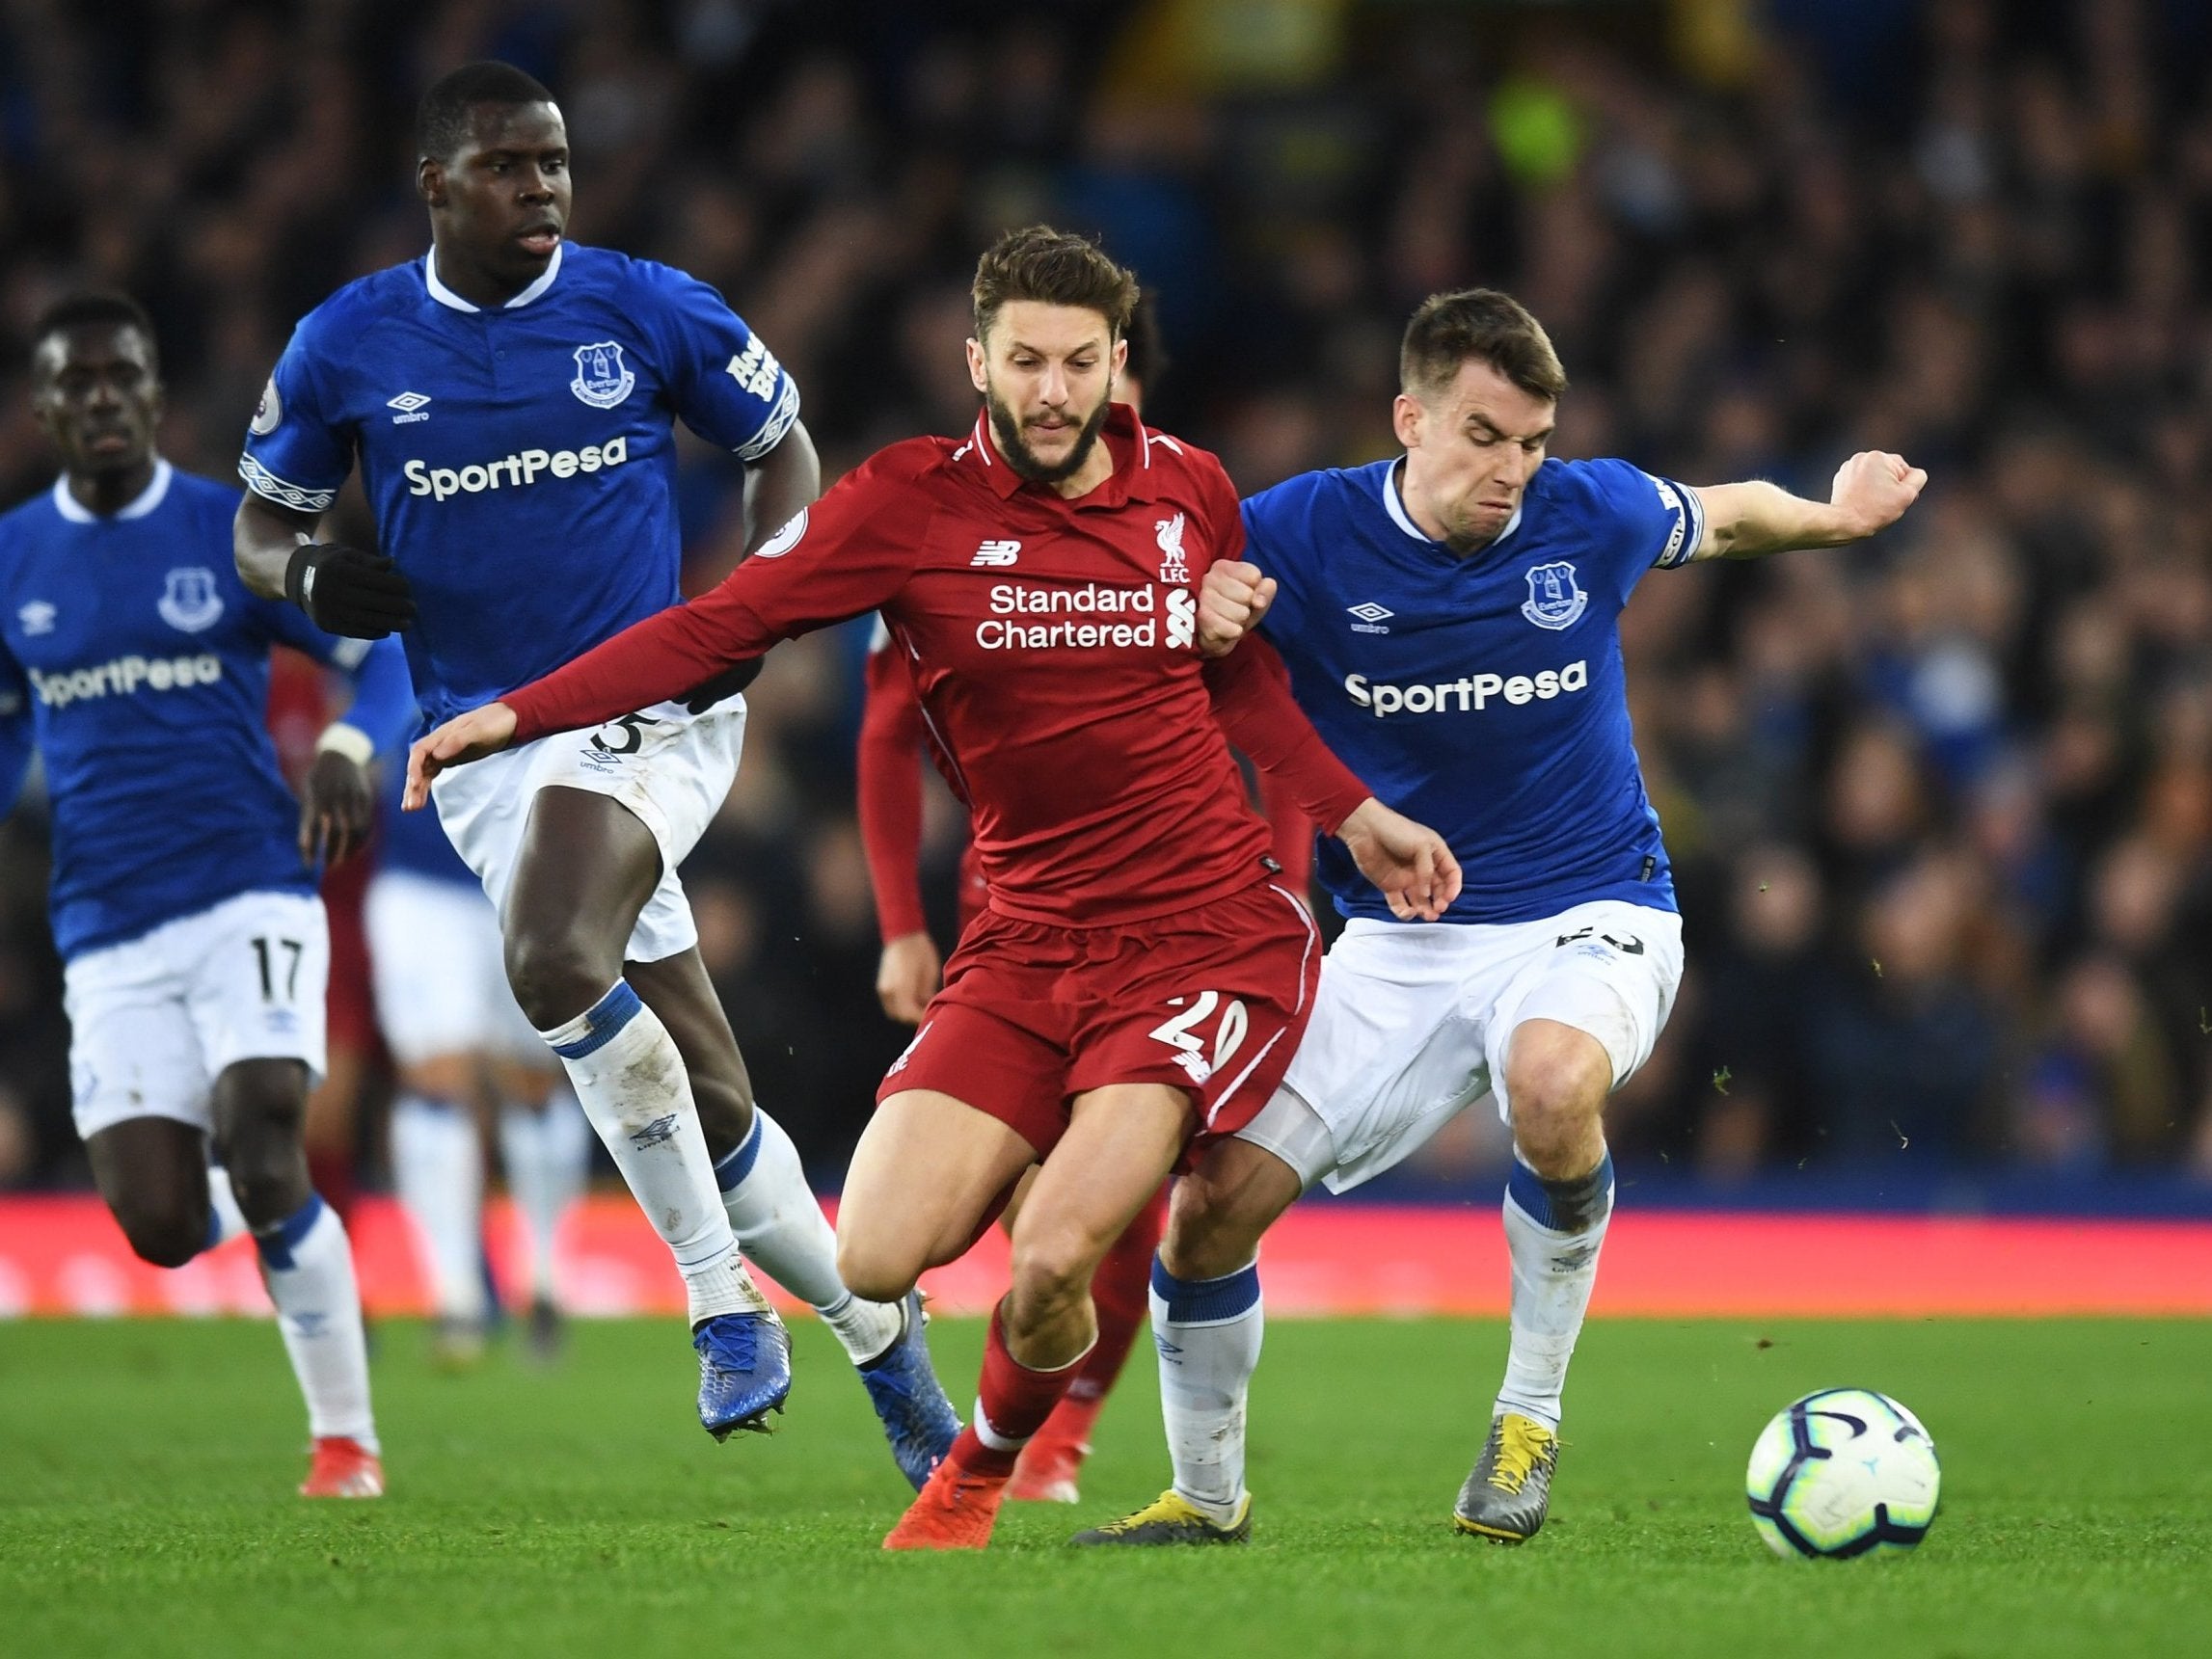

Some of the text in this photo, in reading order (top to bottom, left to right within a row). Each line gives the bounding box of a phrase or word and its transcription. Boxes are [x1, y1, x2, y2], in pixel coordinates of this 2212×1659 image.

[392, 412, 430, 424] umbro
[404, 436, 628, 501] SportPesa
[1159, 568, 1191, 583] LFC
[989, 583, 1154, 614] Standard
[976, 618, 1155, 650] Chartered
[1350, 623, 1389, 634] umbro
[1344, 660, 1587, 718] SportPesa
[580, 761, 615, 774] umbro
[250, 936, 305, 1002] 17
[1147, 990, 1249, 1076] 20
